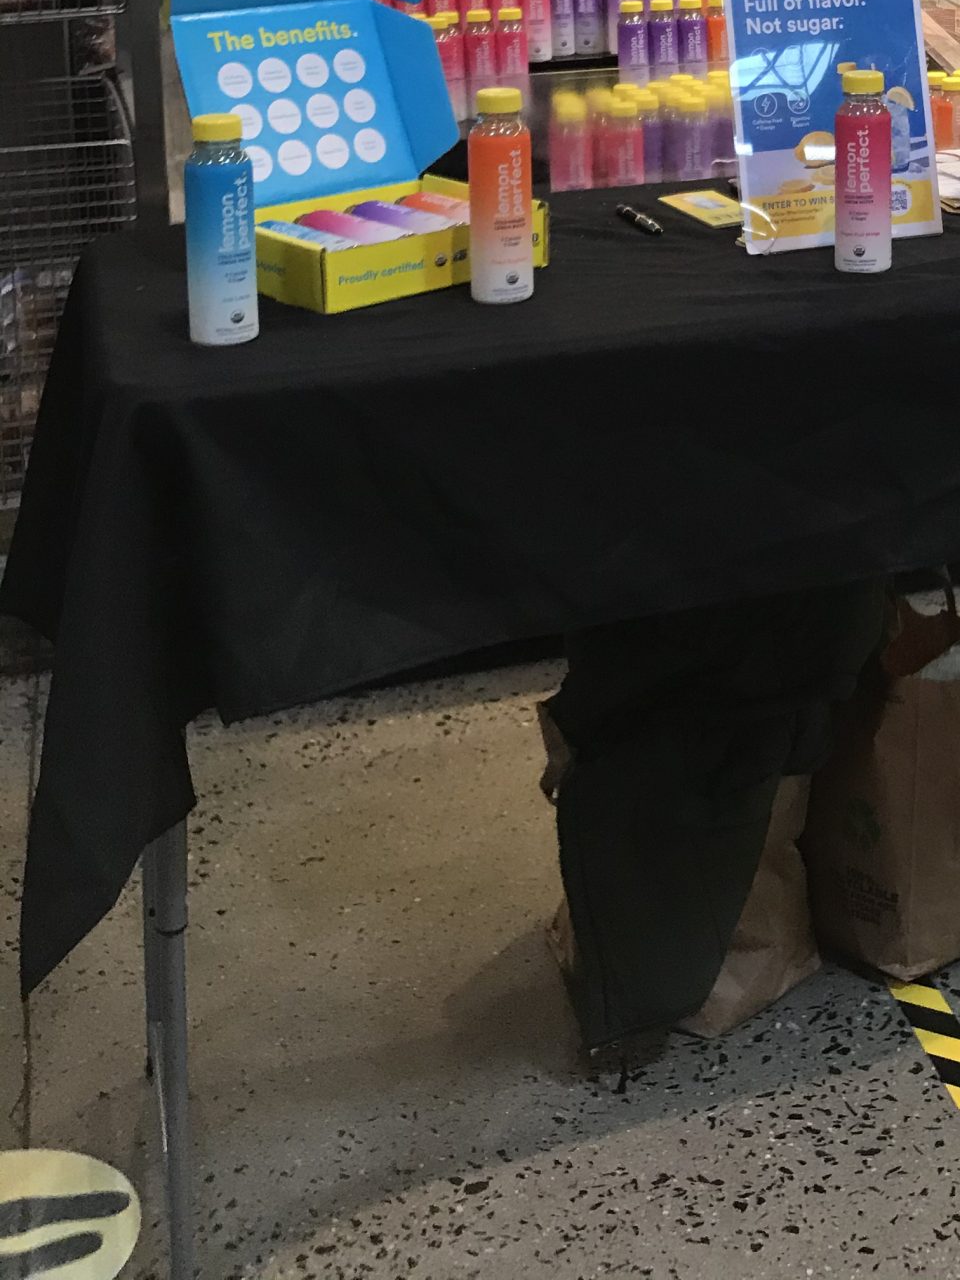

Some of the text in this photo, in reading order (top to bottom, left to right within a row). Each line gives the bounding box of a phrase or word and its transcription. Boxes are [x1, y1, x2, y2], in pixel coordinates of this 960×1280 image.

[207, 20, 359, 54] The benefits.
[746, 17, 782, 35] Not
[844, 142, 857, 193] lemon
[856, 125, 873, 194] perfect.
[495, 162, 509, 219] lemon
[762, 200, 791, 211] ENTER
[795, 198, 807, 207] TO
[809, 195, 827, 206] WIN
[217, 192, 235, 253] lemon
[337, 268, 378, 287] Proudly
